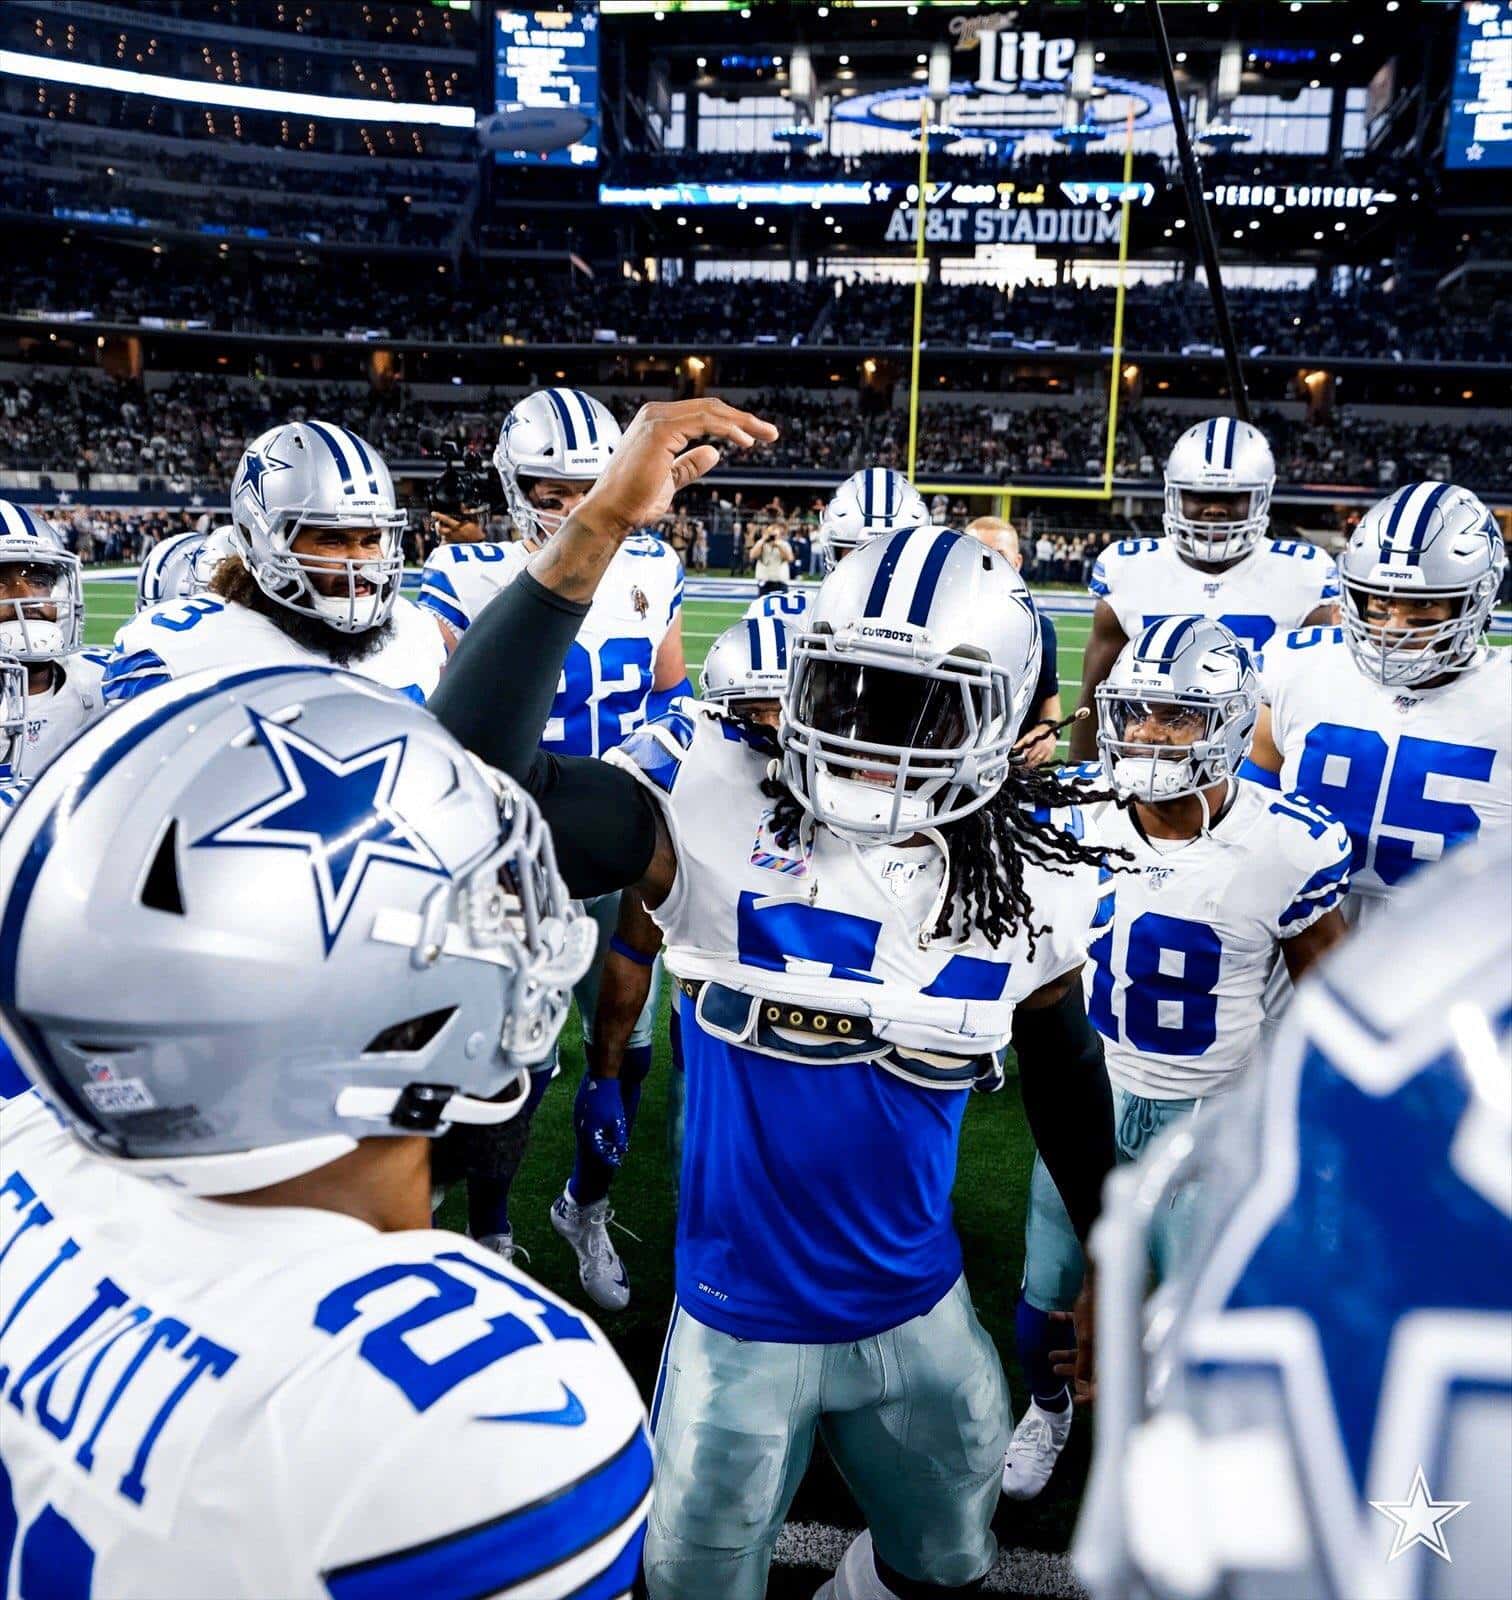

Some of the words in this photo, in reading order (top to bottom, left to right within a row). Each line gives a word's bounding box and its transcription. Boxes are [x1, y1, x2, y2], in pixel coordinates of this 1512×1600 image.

[973, 30, 1075, 94] Lite
[884, 208, 969, 241] AT&T
[974, 208, 1123, 242] STADIUM
[862, 626, 913, 643] COWBOYS
[1296, 722, 1497, 886] 95
[1088, 911, 1222, 1056] 18
[698, 1282, 729, 1302] DRI-FIT
[313, 1252, 597, 1414] 21
